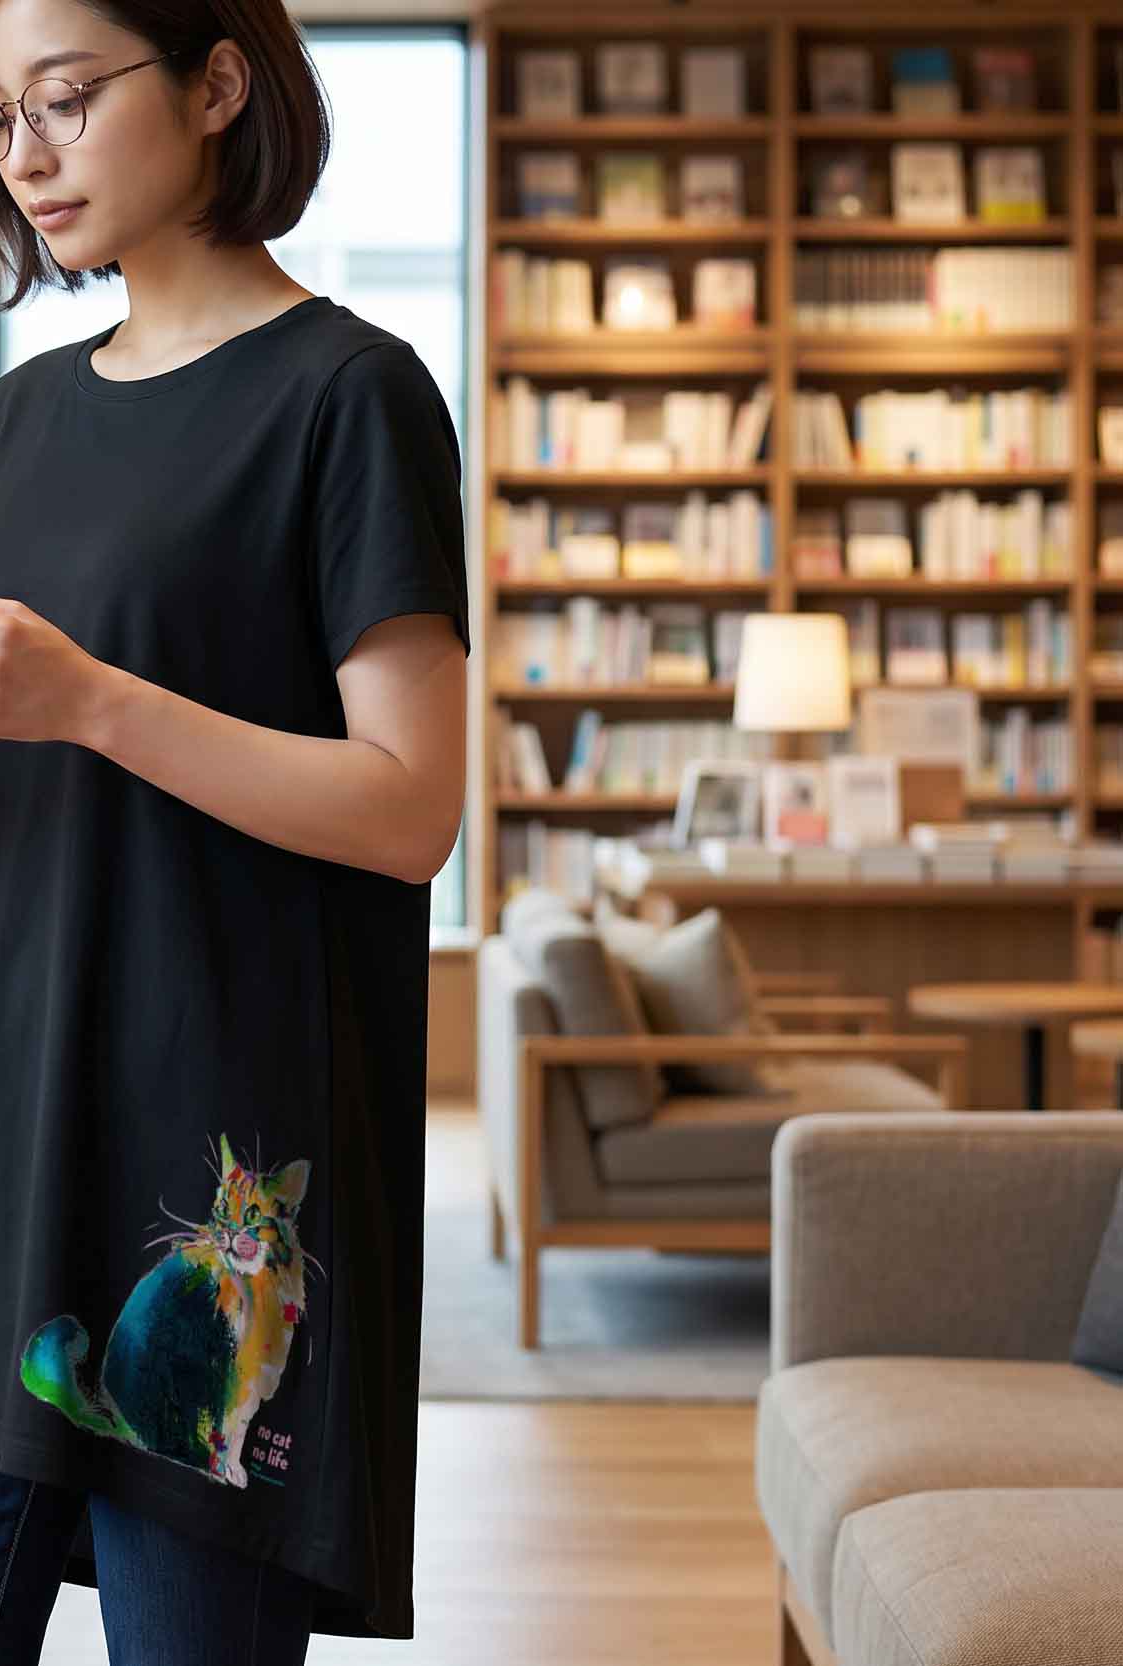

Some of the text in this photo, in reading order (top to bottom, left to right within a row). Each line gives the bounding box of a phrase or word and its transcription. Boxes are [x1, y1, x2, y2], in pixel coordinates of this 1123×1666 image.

[258, 1426, 292, 1448] no cat
[253, 1447, 287, 1470] no life
